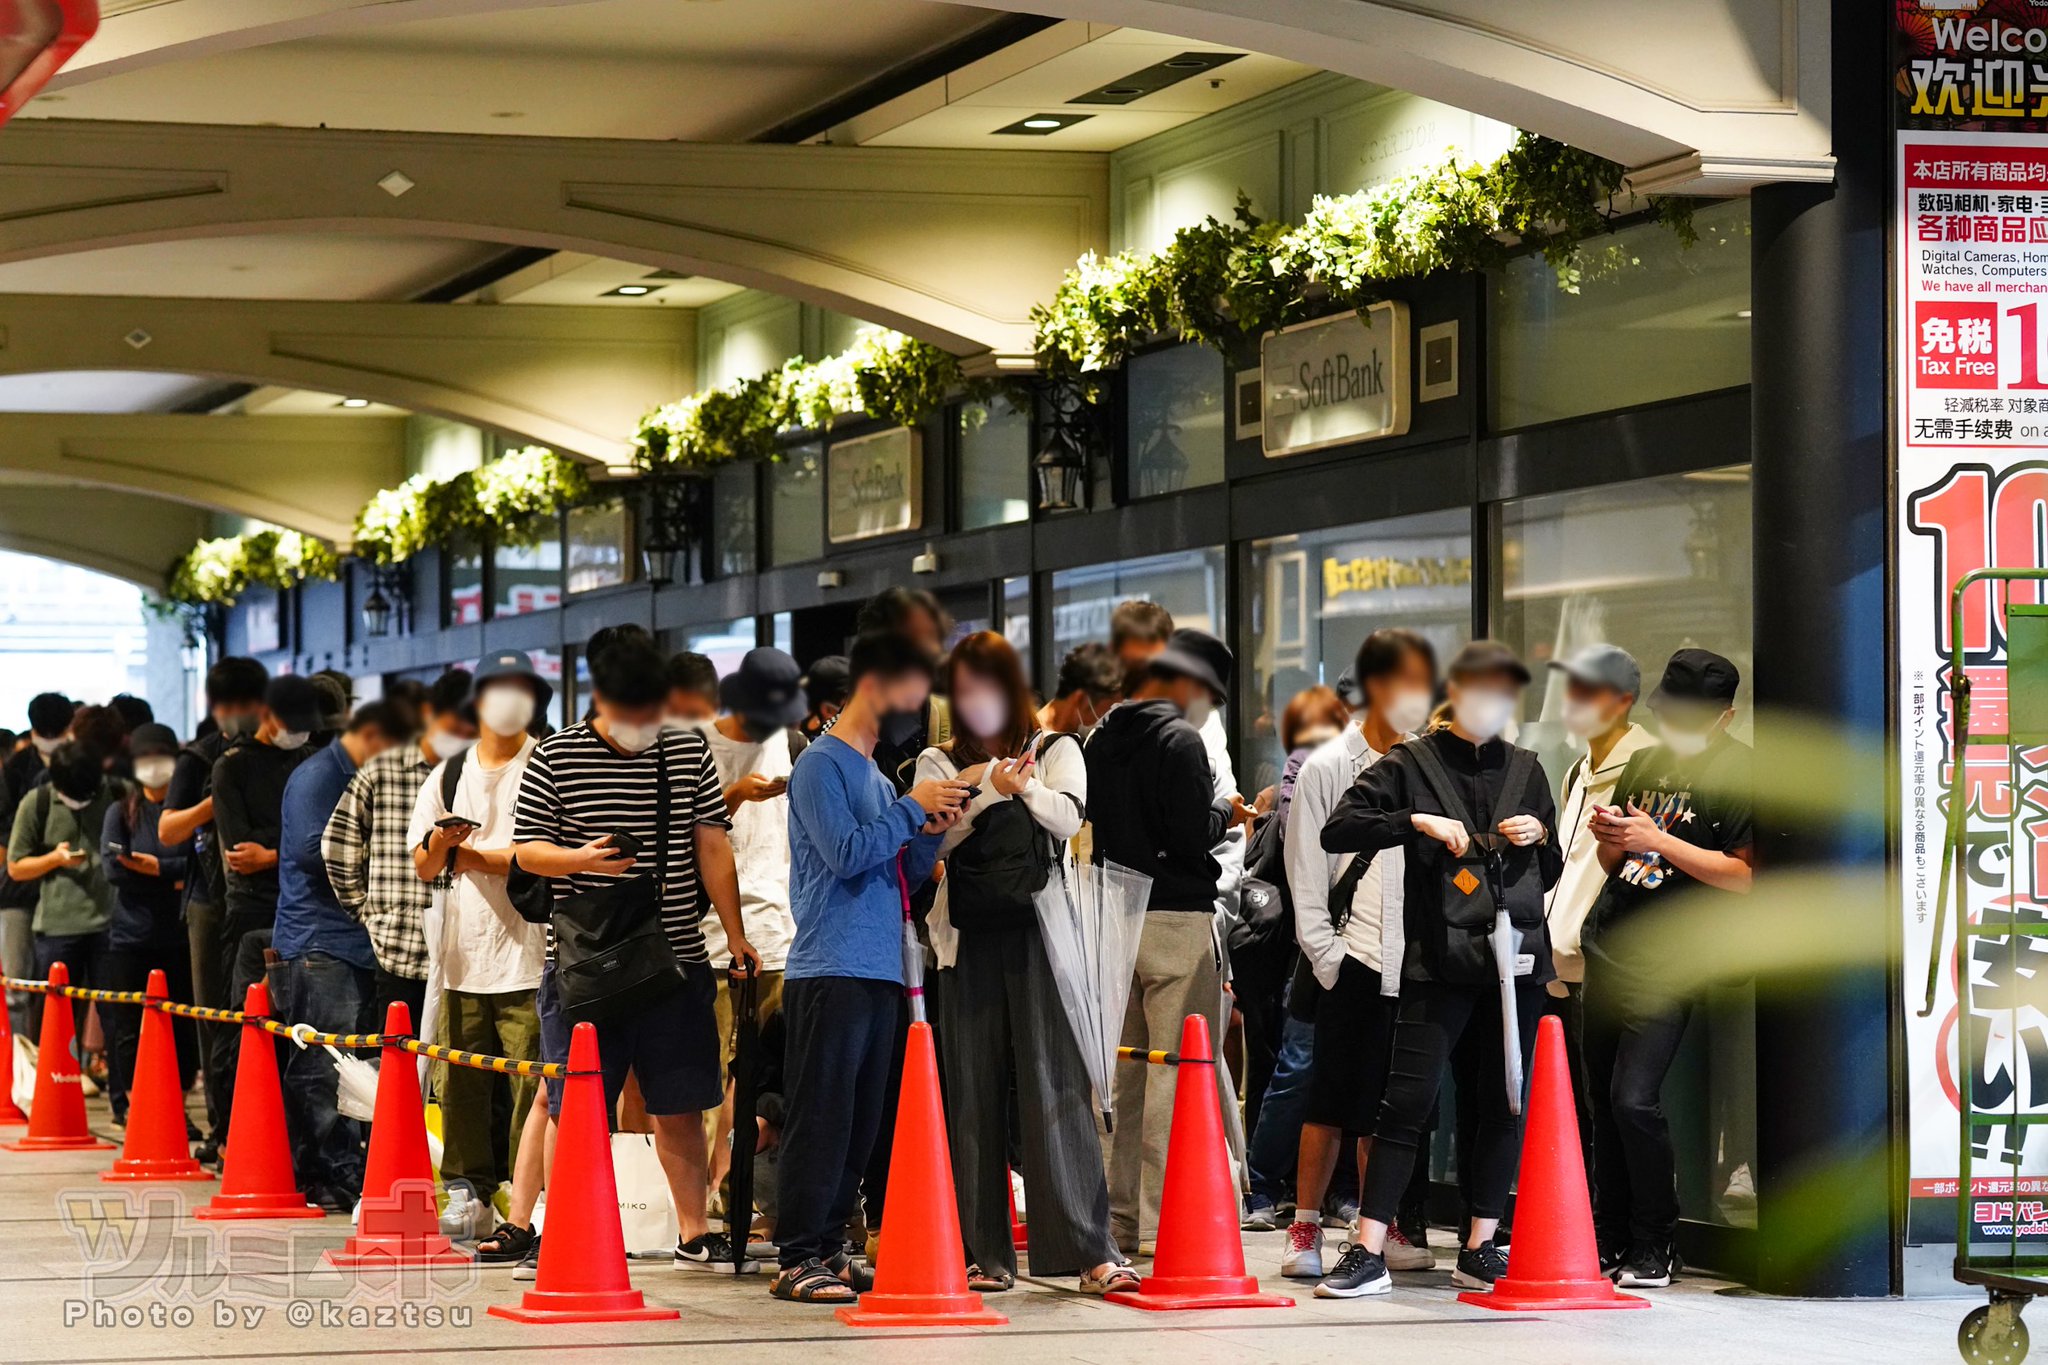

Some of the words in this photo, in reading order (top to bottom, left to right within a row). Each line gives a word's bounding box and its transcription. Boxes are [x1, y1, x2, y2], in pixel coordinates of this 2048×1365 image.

[1932, 18, 2048, 53] Welco
[1913, 159, 2048, 182] 本店所有商品均
[1922, 250, 1960, 263] Digital
[1964, 250, 2020, 263] Cameras,
[1922, 263, 1977, 276] Watches,
[1921, 280, 1941, 291] We
[1944, 280, 1973, 292] have
[1977, 281, 1991, 292] all
[1995, 282, 2048, 293] merchan
[1921, 317, 1993, 355] 免税
[1918, 356, 1950, 375] Tax
[1955, 357, 1996, 375] Free
[1300, 347, 1384, 411] SoftBank
[1914, 418, 2013, 440] 无需手续费
[2020, 426, 2039, 438] on
